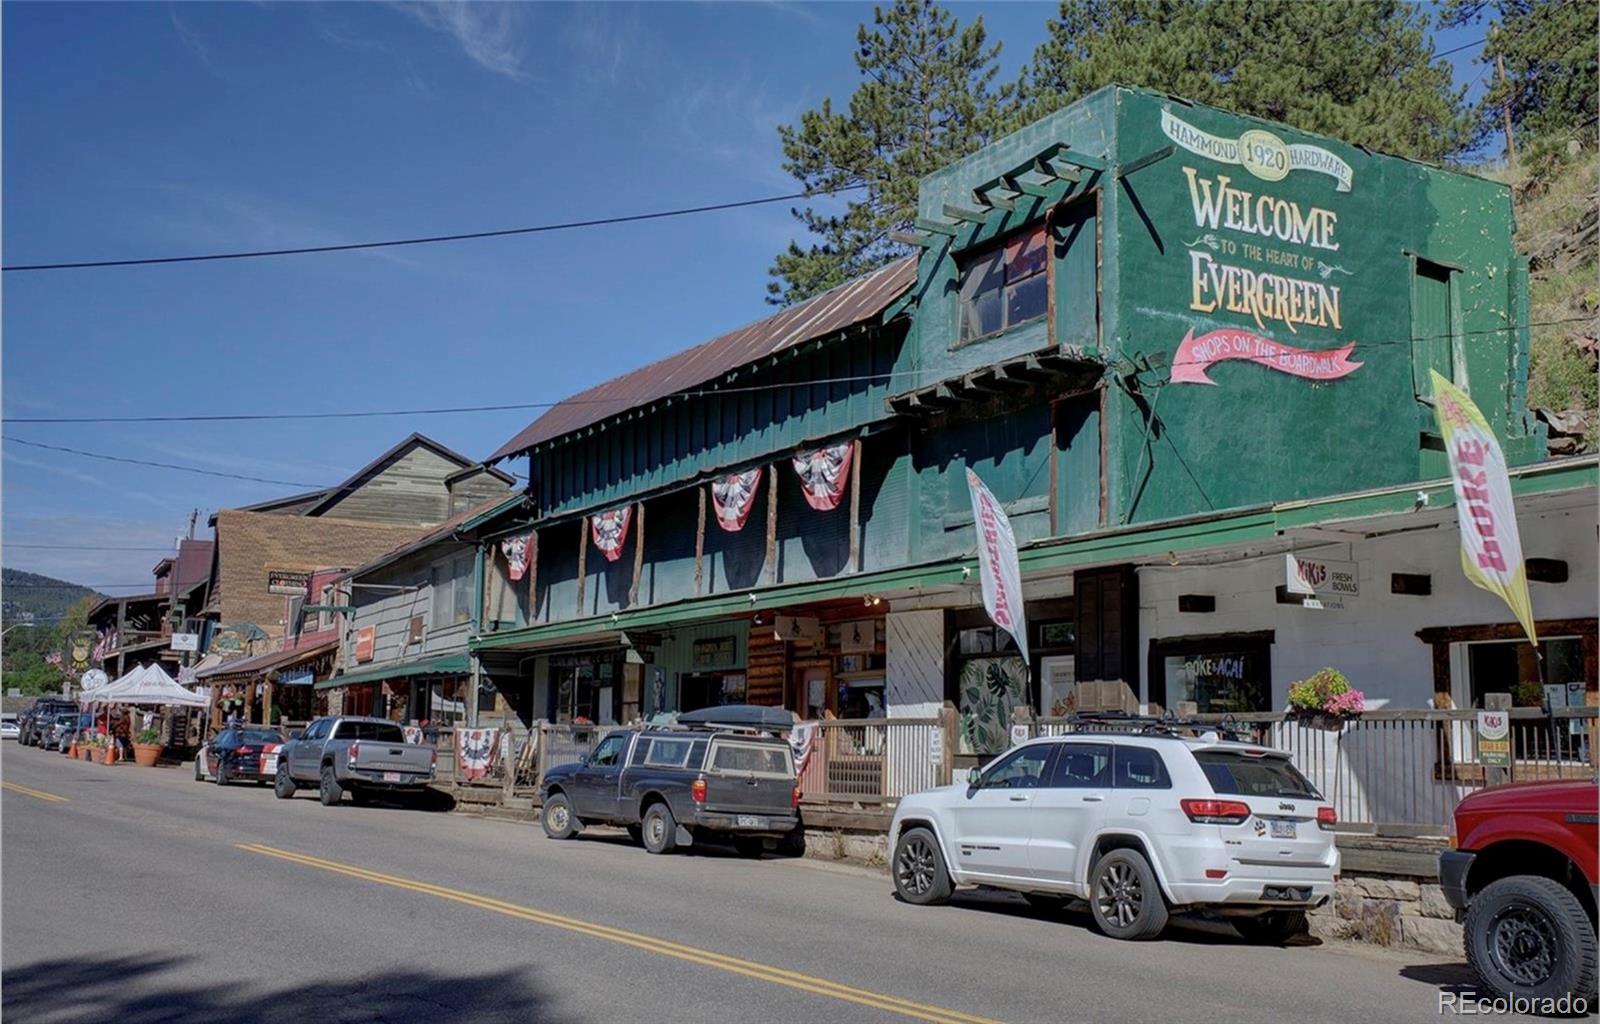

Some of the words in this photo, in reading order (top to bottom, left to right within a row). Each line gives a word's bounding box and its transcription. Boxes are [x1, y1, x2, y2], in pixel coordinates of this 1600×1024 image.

[1169, 120, 1236, 160] HAMMOND
[1247, 142, 1285, 171] 1920
[1290, 150, 1347, 179] HARDWARE
[1182, 165, 1340, 251] WELCOME
[1220, 239, 1236, 254] TO
[1242, 243, 1262, 262] THE
[1266, 249, 1298, 268] HEART
[1301, 257, 1315, 271] OF
[1188, 250, 1342, 334] EVERGREEN
[1191, 335, 1231, 363] SHOPS
[1232, 335, 1250, 351] ON
[1254, 339, 1276, 361] THE
[1279, 350, 1342, 374] BOARDWALK
[1331, 572, 1353, 582] FRESH
[1332, 582, 1358, 593] BOWLS
